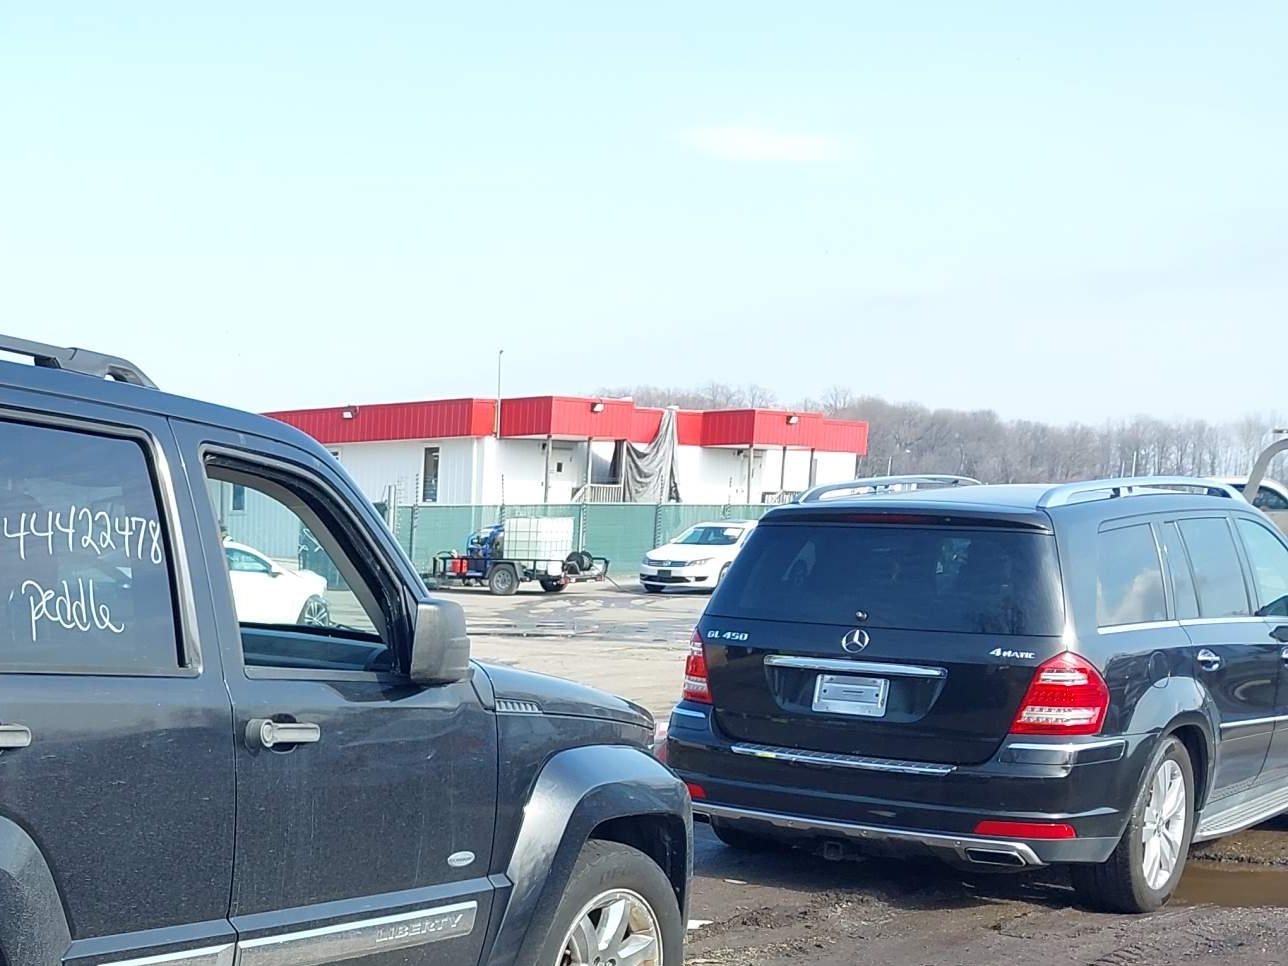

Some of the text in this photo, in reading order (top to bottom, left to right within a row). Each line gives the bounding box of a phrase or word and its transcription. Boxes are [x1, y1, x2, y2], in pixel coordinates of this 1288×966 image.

[3, 504, 163, 564] 44422478
[722, 631, 749, 641] 450
[376, 913, 464, 943] LIBERTY
